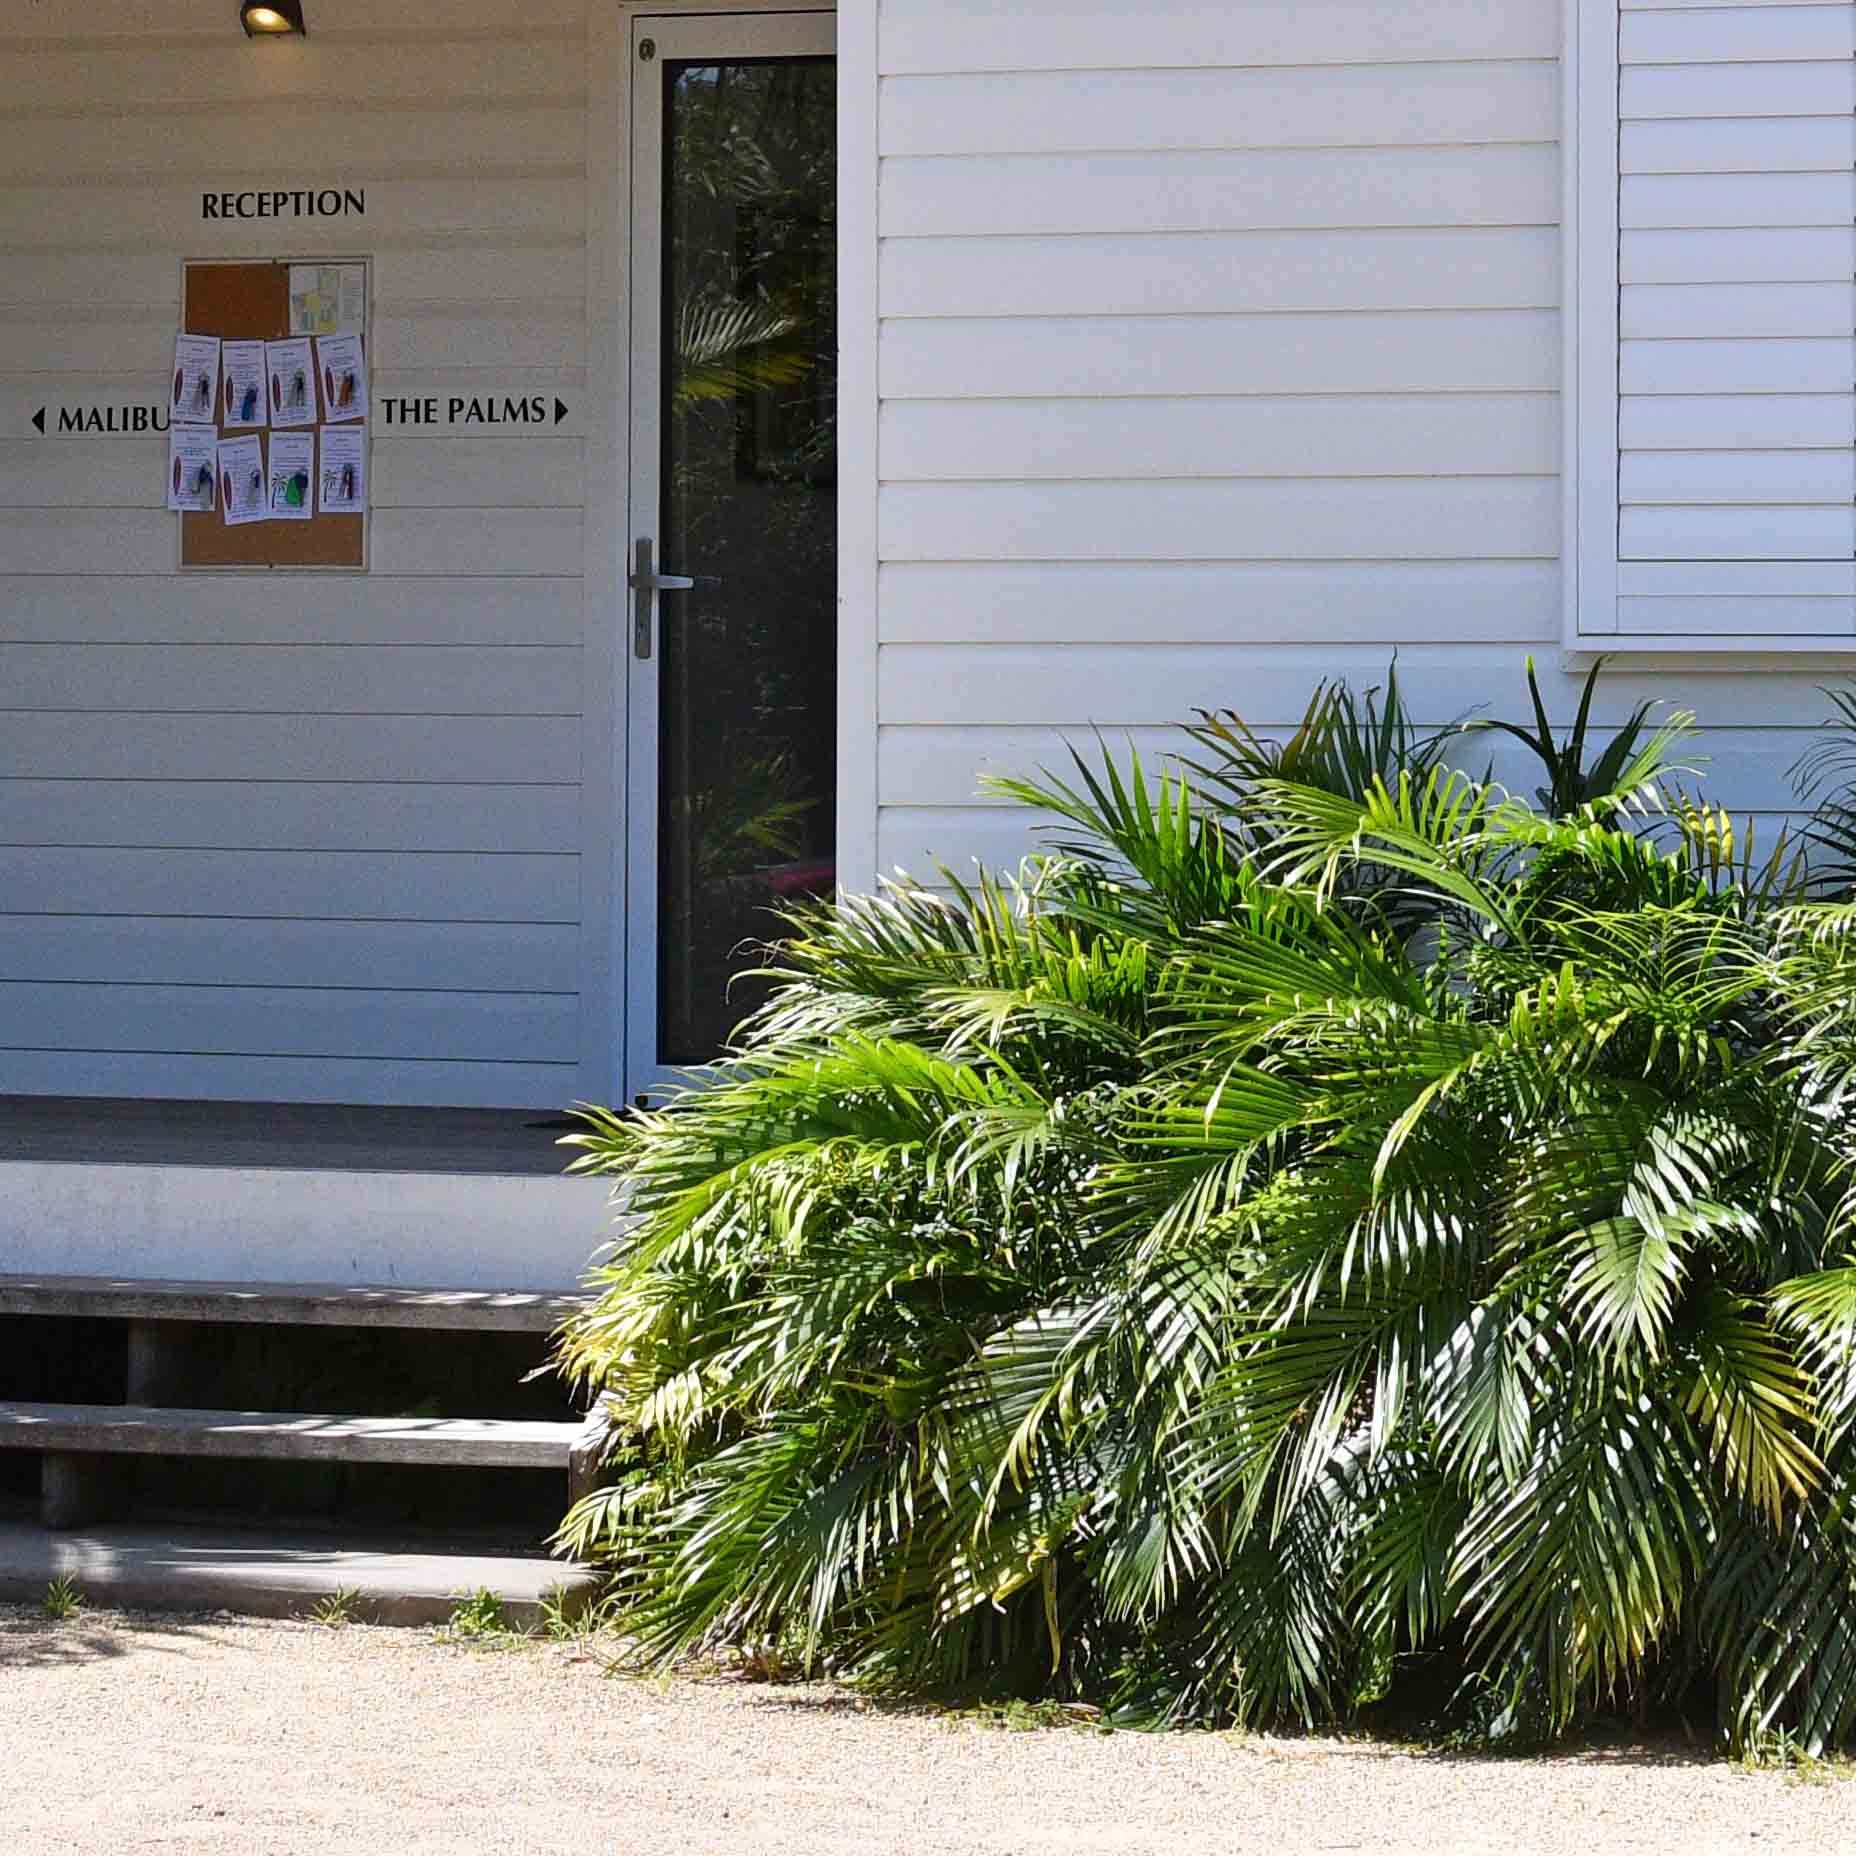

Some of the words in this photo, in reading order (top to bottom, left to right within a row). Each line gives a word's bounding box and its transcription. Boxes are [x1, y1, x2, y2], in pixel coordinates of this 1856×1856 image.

[201, 189, 365, 219] RECEPTION
[58, 406, 170, 432] MALIBU
[381, 398, 439, 424] THE
[448, 396, 546, 424] PALMS
